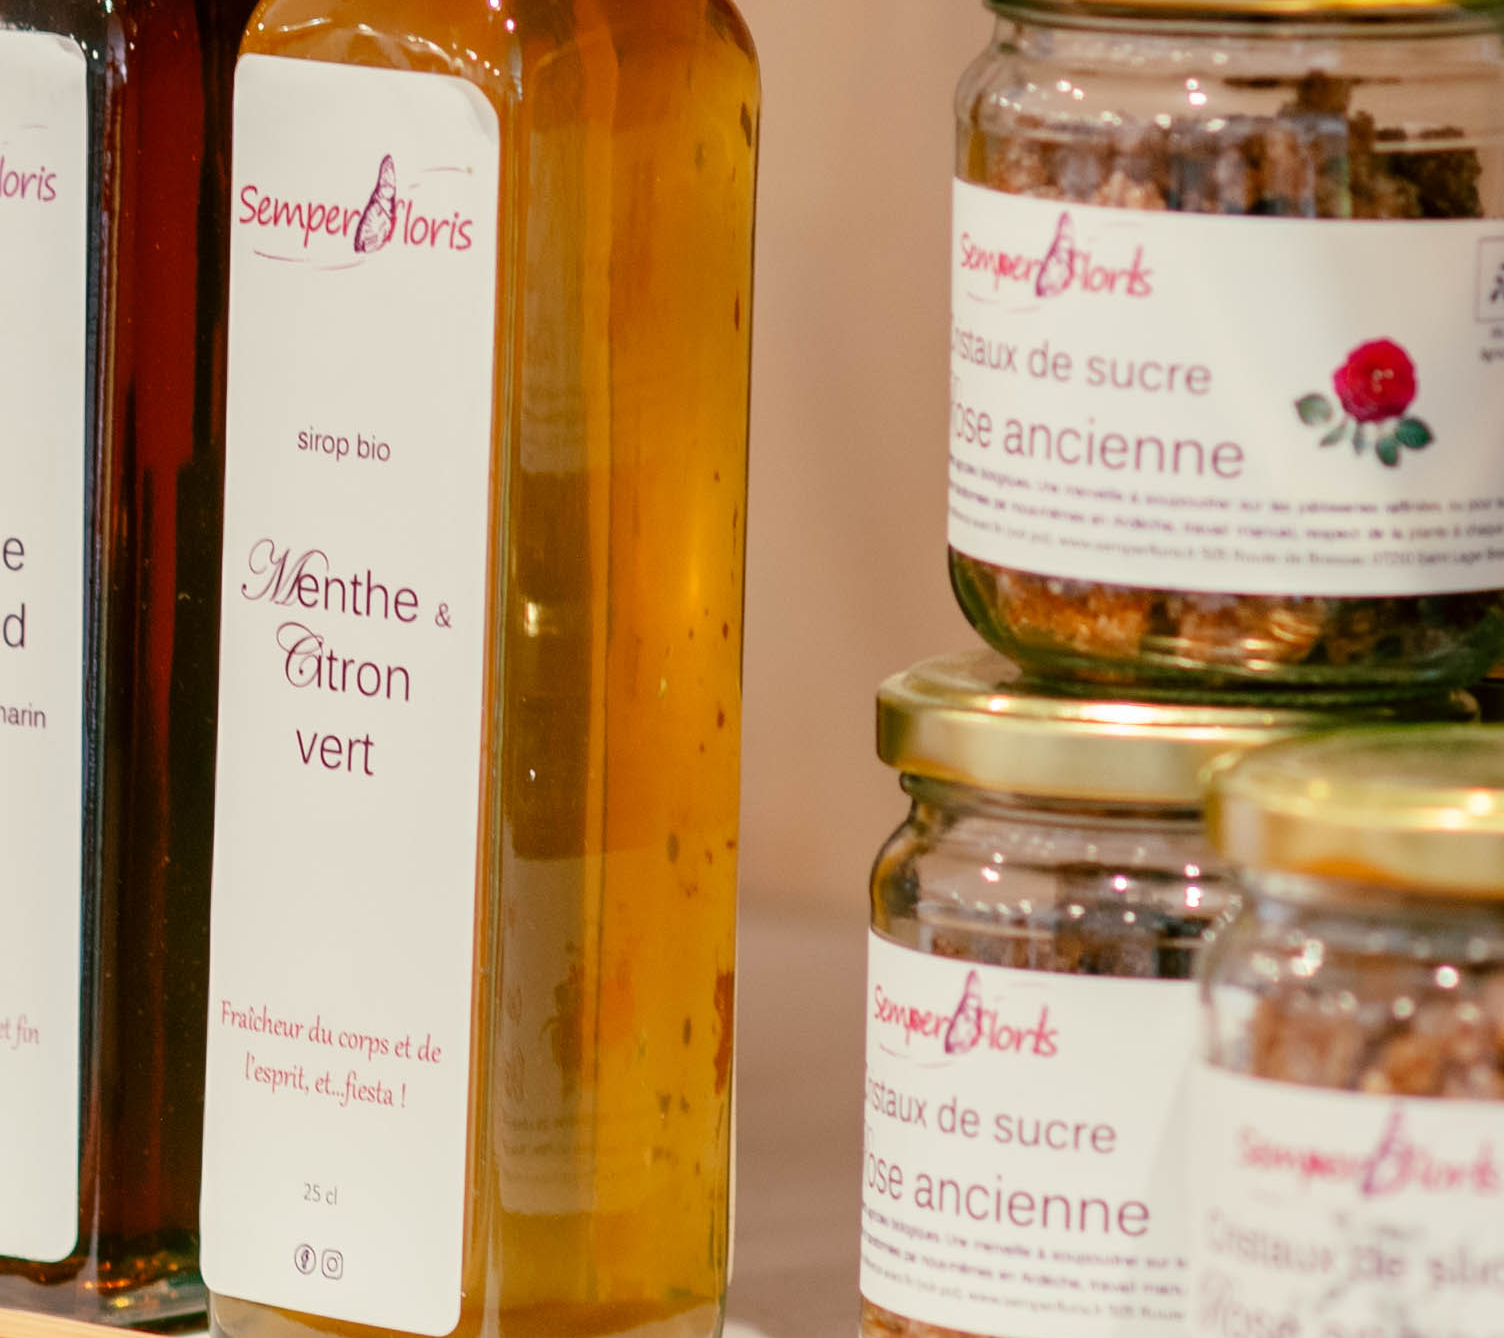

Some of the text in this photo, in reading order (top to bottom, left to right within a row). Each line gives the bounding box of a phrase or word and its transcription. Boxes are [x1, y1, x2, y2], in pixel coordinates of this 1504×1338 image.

[238, 169, 473, 253] Semperfloris
[1027, 341, 1212, 397] de sucre
[297, 426, 392, 463] sirop bio
[1003, 417, 1245, 481] ancienne
[241, 538, 452, 629] Menthe &
[275, 622, 411, 703] Citron
[295, 728, 375, 776] vert
[220, 998, 443, 1065] Fraîcheur du corps et de
[244, 1052, 310, 1096] l'esprit,
[399, 1082, 407, 1110] !
[937, 1096, 1118, 1155] de sucre
[303, 1182, 338, 1208] 25 cl
[913, 1171, 1151, 1239] ancienne
